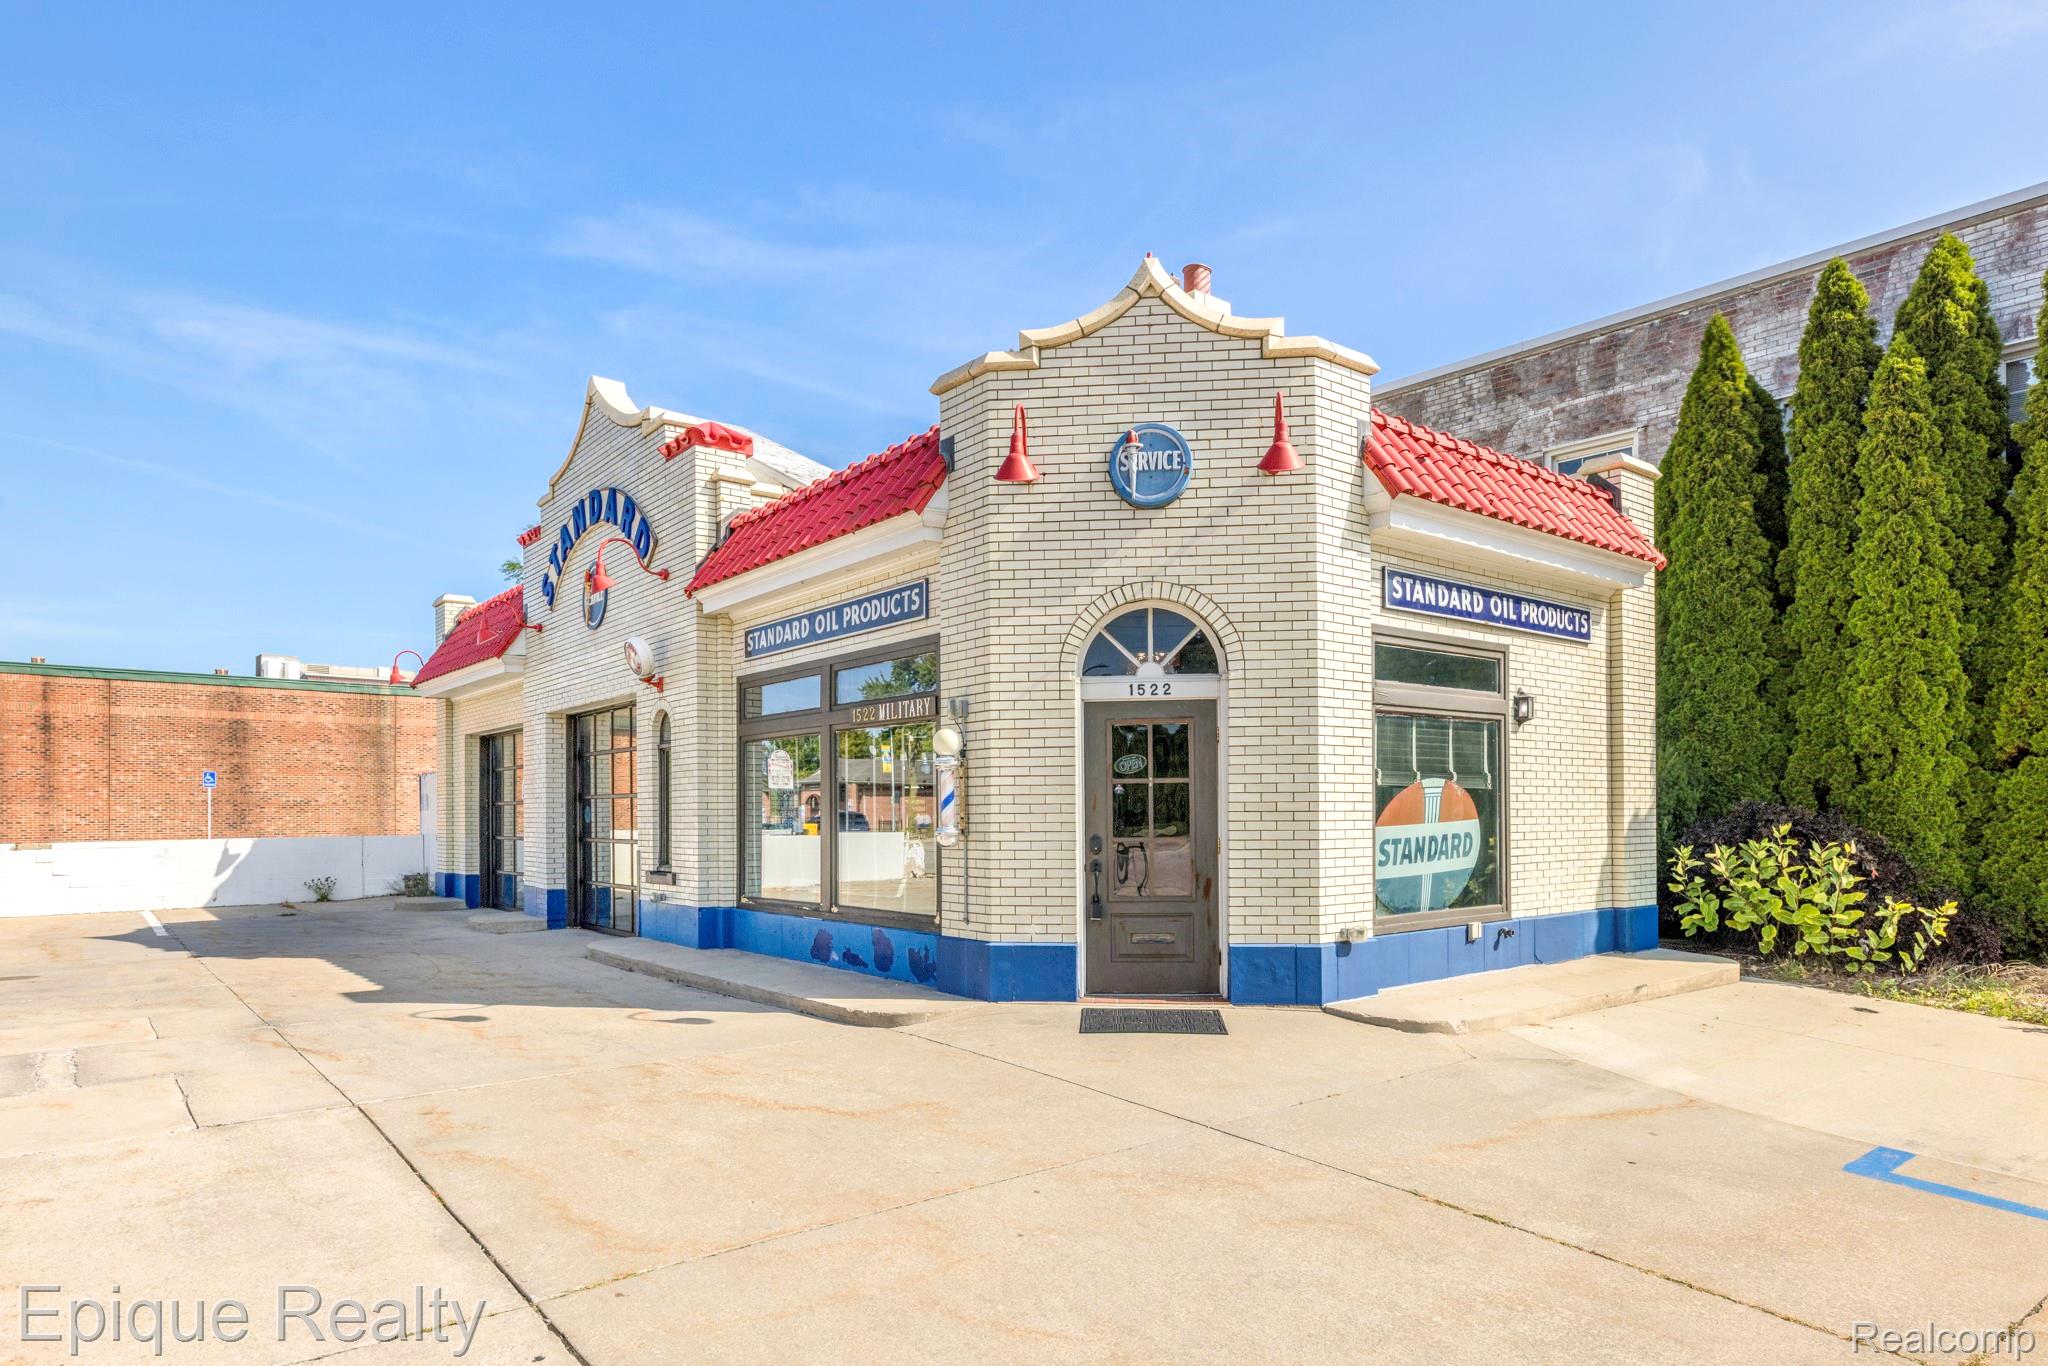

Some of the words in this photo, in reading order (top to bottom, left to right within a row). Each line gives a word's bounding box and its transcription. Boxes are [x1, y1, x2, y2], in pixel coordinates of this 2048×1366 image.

[1120, 450, 1181, 471] SRVICE
[541, 487, 651, 607] STANDARD
[747, 618, 810, 652] STANDARD
[815, 610, 839, 634] OIL
[843, 588, 920, 628] PRODUCTS
[1392, 576, 1484, 614] STANDARD
[1490, 595, 1517, 620] OIL
[1521, 601, 1588, 634] PRODUCTS
[1129, 683, 1172, 696] 1522
[852, 706, 876, 722] 1522
[878, 697, 931, 721] MILITARY
[1119, 757, 1144, 772] OPEN
[1378, 831, 1473, 867] STANDARD
